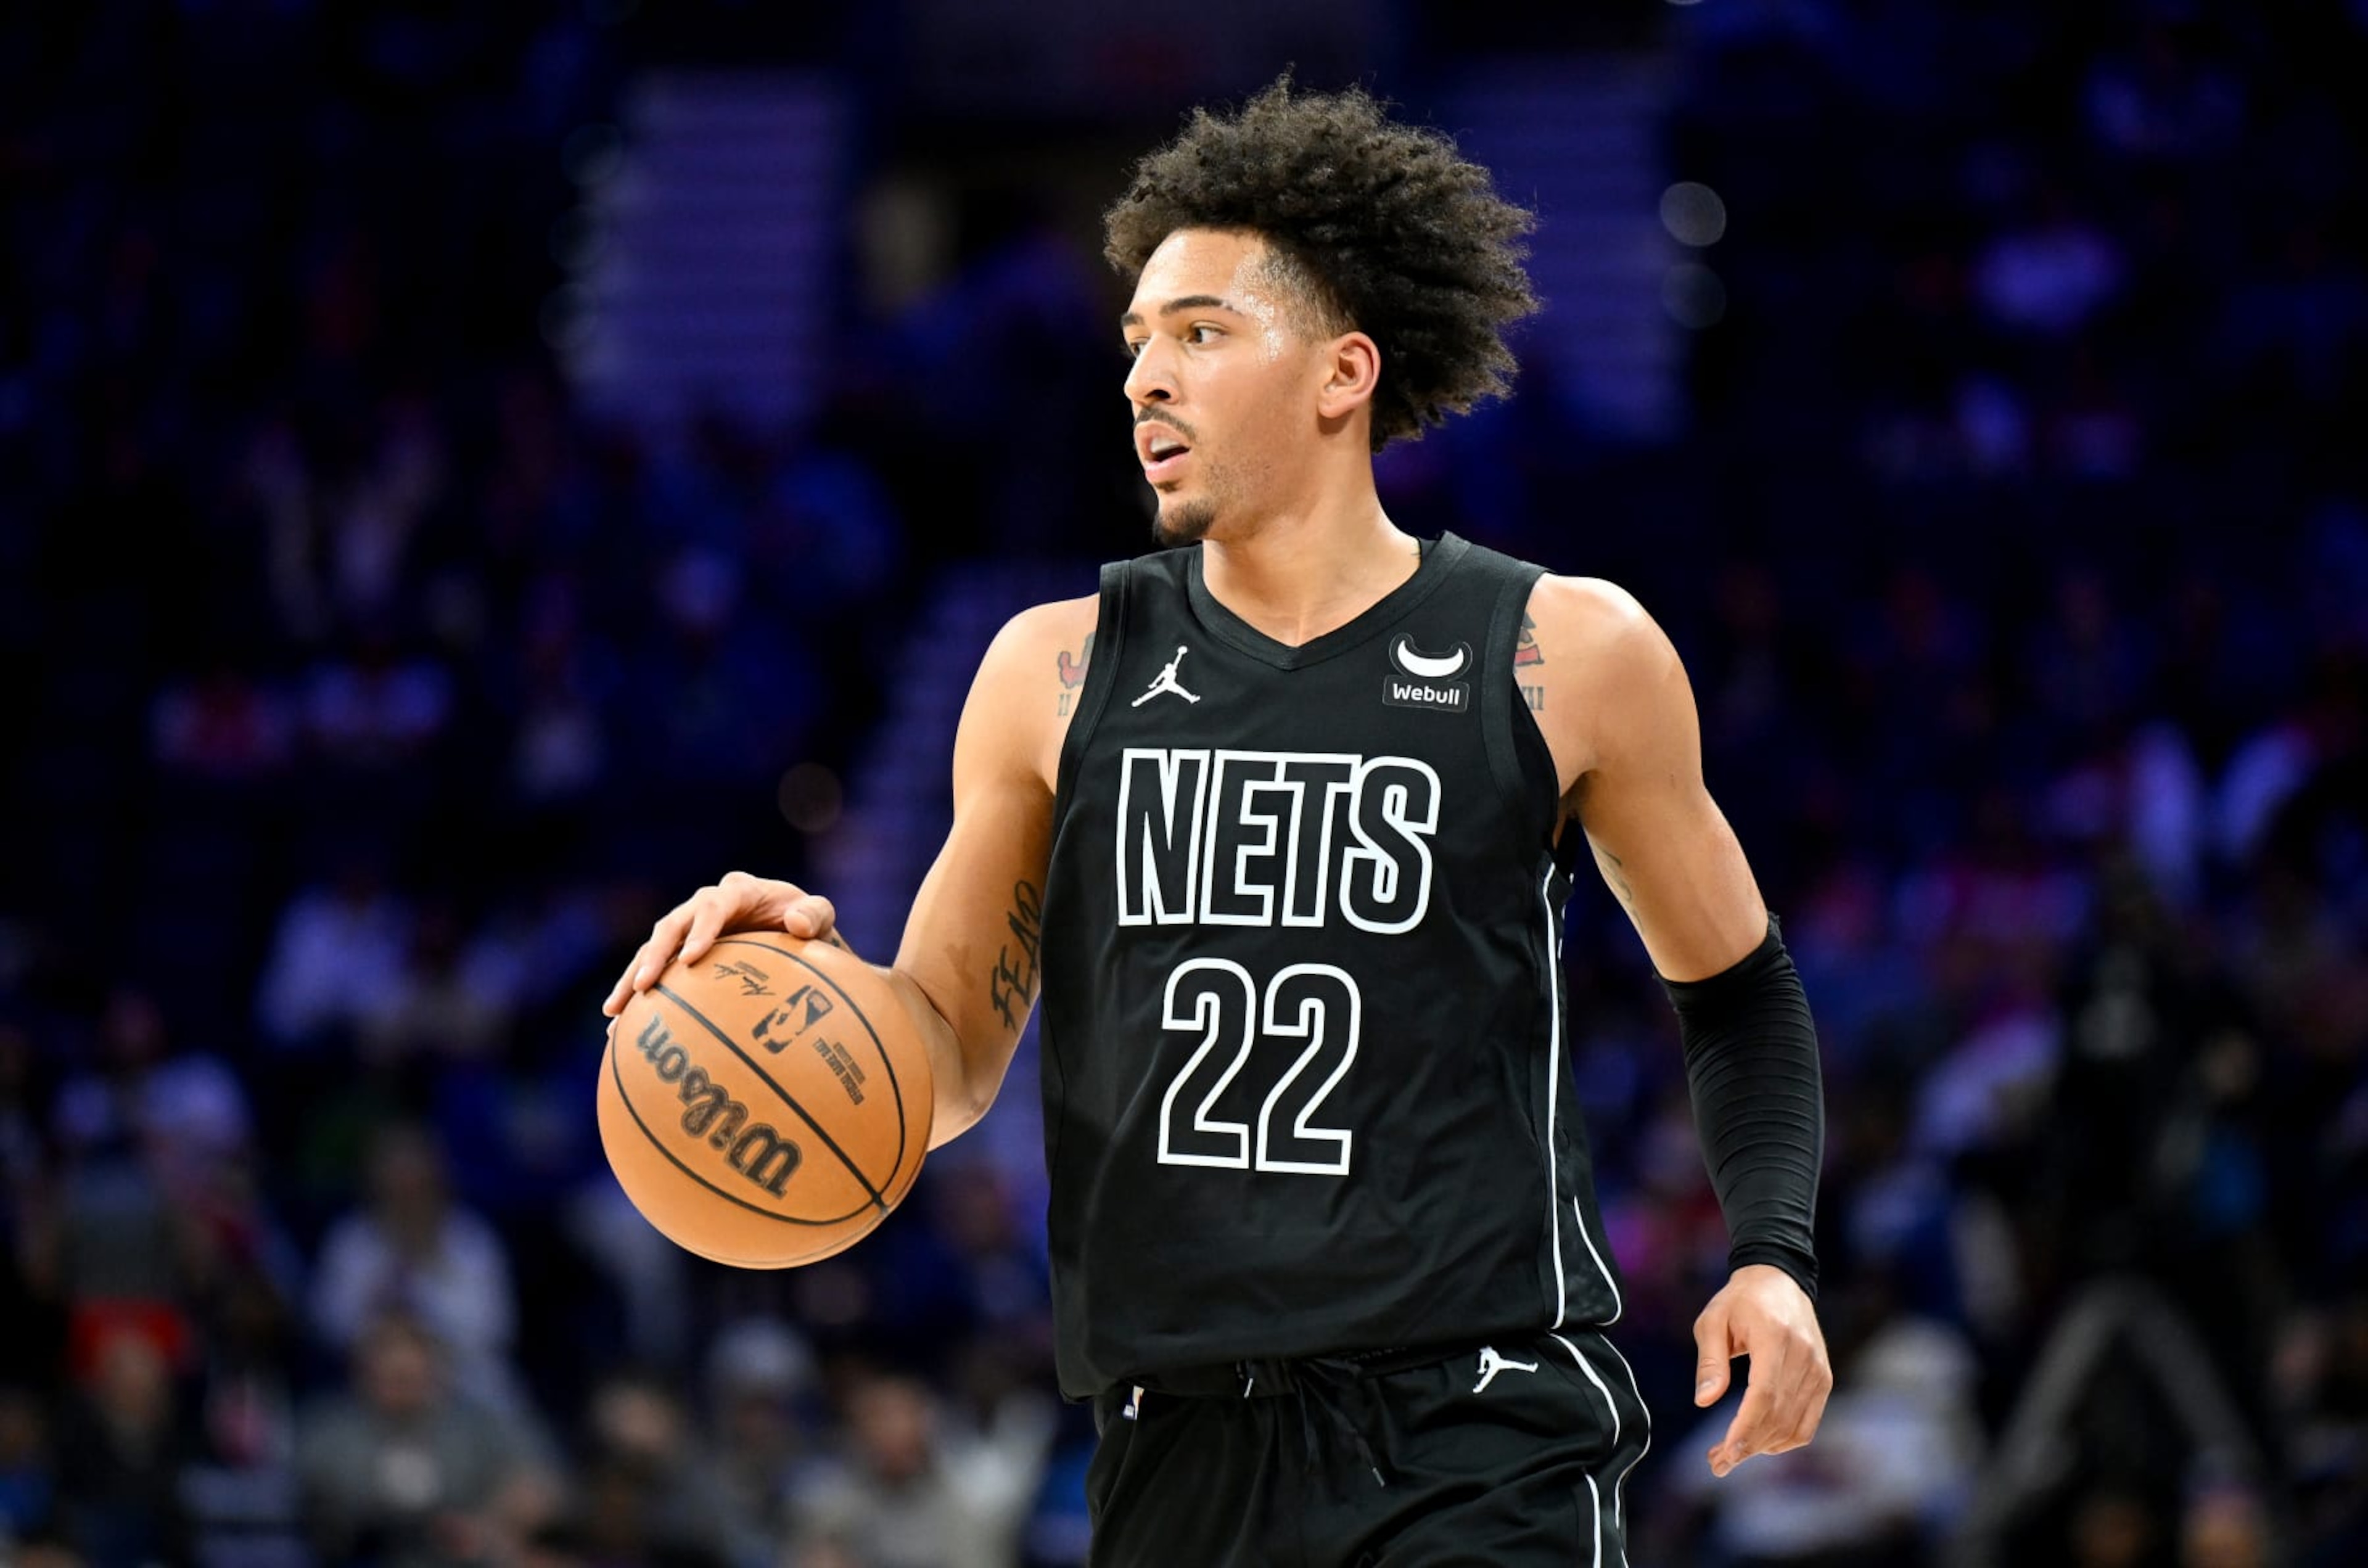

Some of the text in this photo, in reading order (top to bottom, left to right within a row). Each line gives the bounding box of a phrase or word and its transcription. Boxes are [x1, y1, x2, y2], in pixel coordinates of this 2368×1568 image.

[1393, 683, 1460, 705] Webull
[1116, 748, 1442, 935] NETS
[636, 1011, 802, 1200] Wilson
[1157, 958, 1361, 1176] 22
